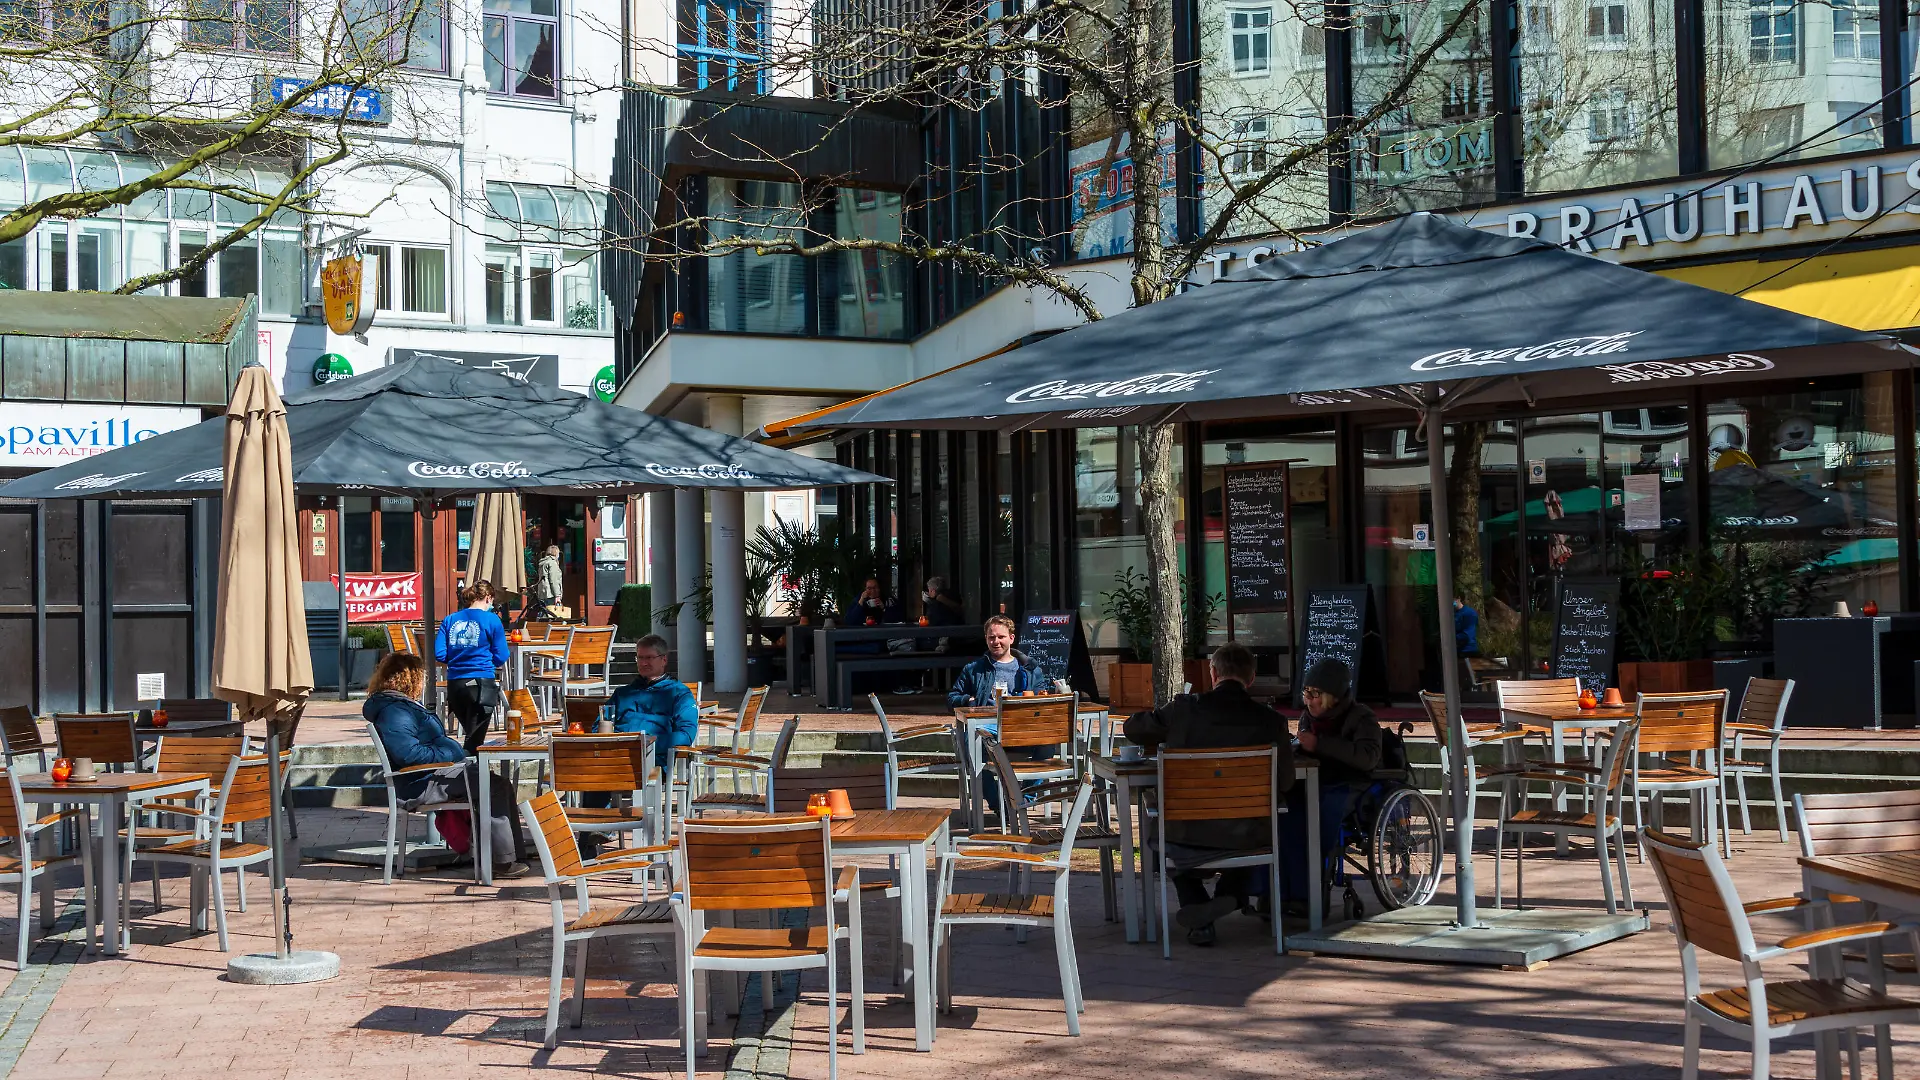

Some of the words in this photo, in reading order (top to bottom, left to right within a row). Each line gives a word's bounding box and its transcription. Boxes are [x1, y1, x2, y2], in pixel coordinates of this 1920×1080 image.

[1411, 330, 1645, 371] Coca-Cola
[22, 447, 52, 456] AM
[407, 461, 532, 479] Coca-Cola
[645, 463, 756, 479] Coca-Cola
[345, 602, 417, 613] ERGARTEN
[1028, 615, 1041, 625] sky
[1042, 616, 1068, 624] SPORT
